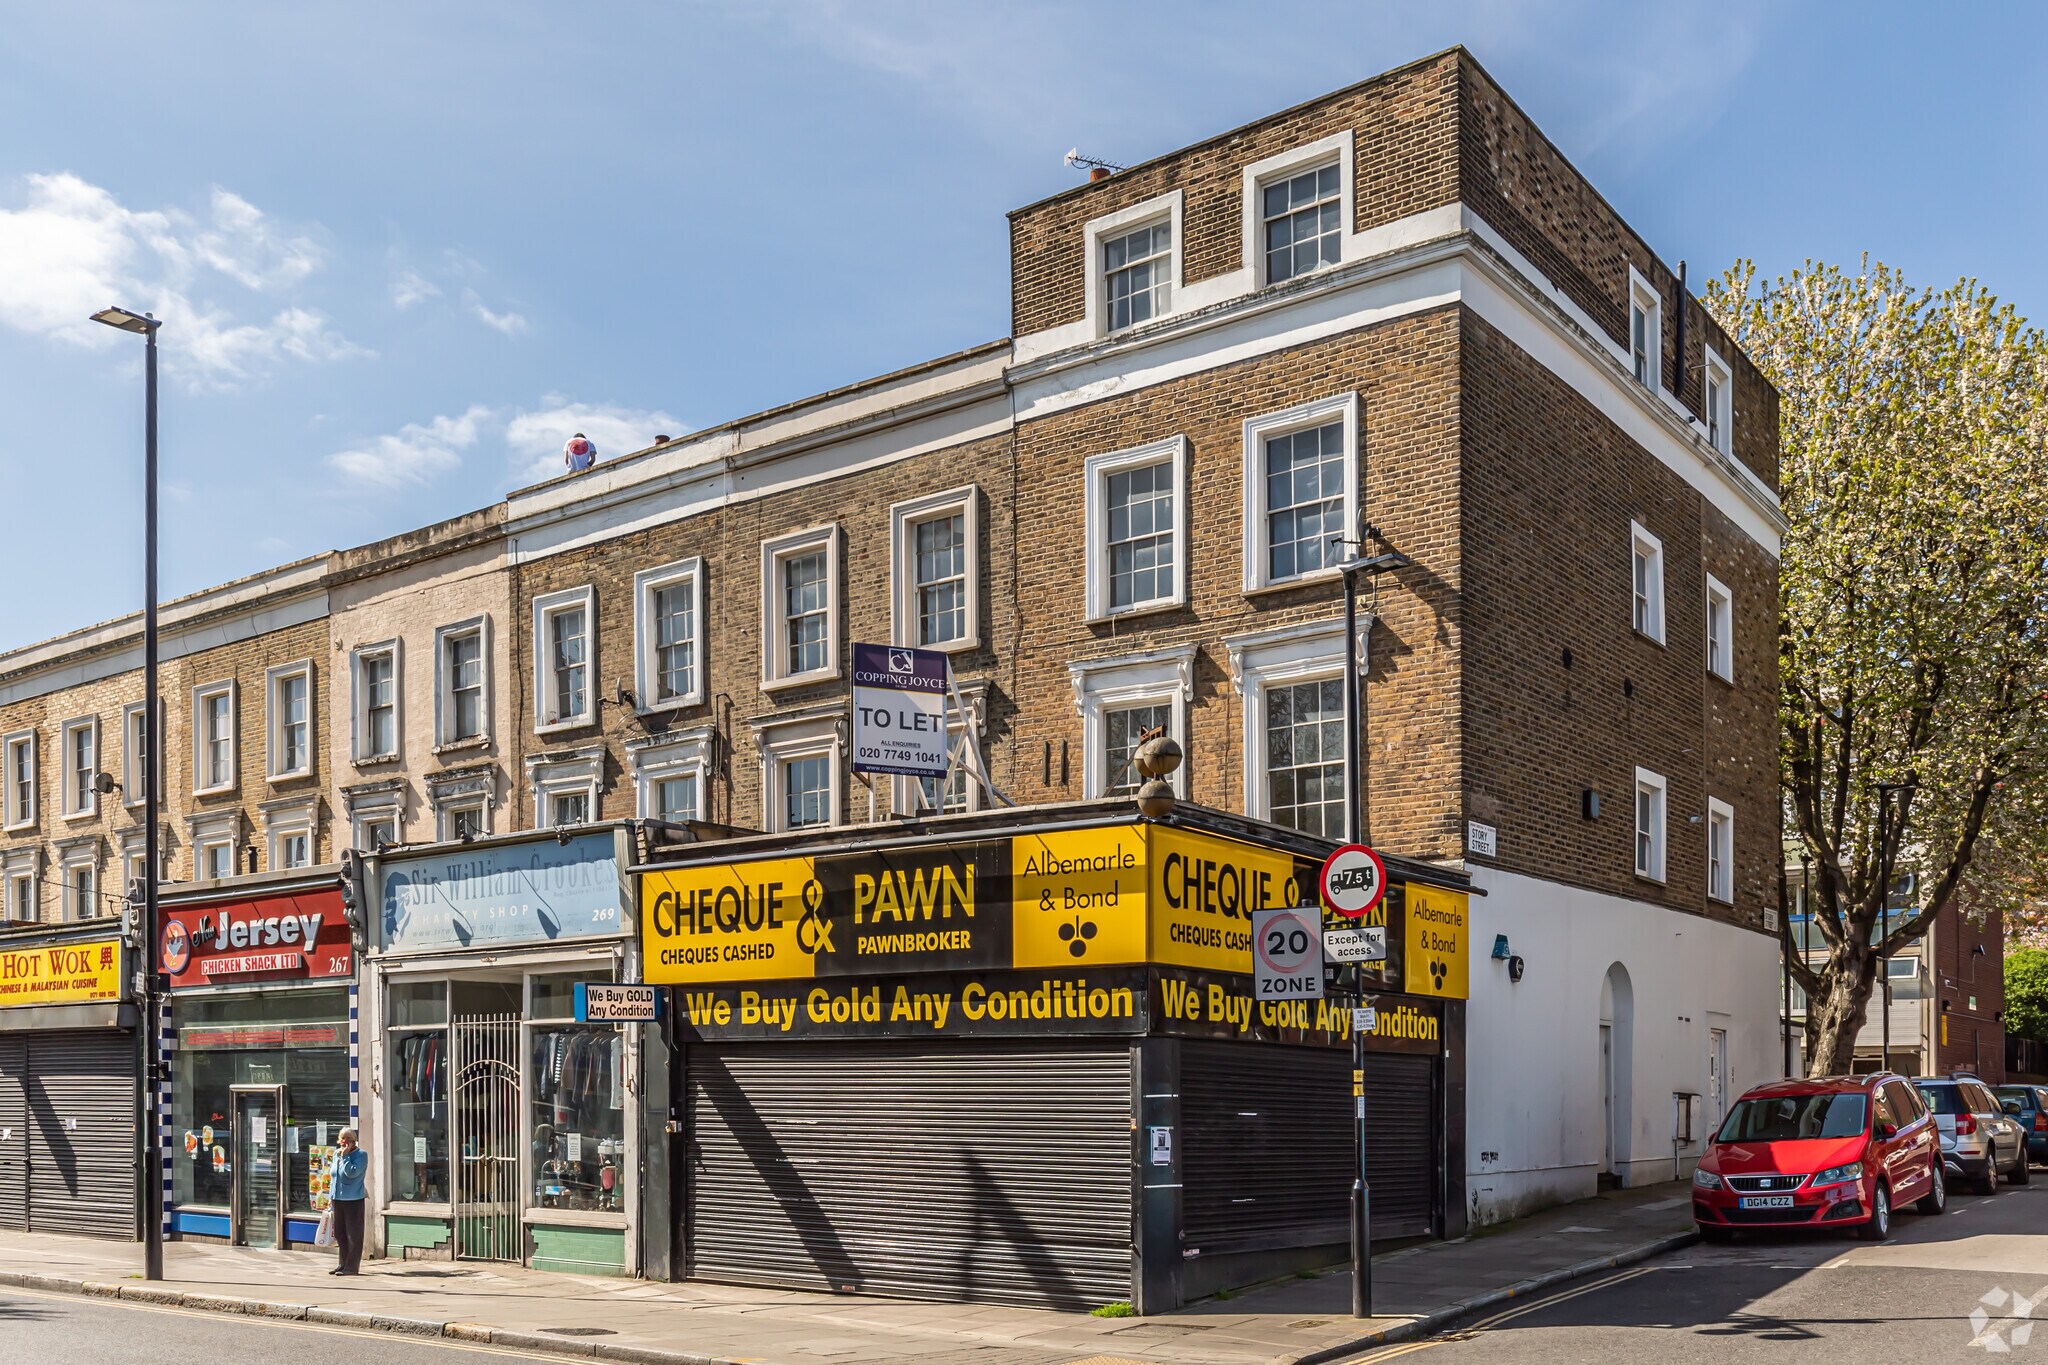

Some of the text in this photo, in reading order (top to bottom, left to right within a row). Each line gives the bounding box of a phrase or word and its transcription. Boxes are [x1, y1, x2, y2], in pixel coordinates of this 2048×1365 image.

[855, 671, 945, 689] COPPING JOYCE
[859, 707, 943, 732] TO LET
[860, 747, 940, 763] 020 7749 1041
[865, 765, 936, 776] www.coppingjoyce.co.uk
[1472, 828, 1488, 841] STORY
[1472, 840, 1490, 853] STREET
[1023, 843, 1136, 878] Albemarle
[411, 847, 615, 905] Sir William Crookes
[1163, 852, 1271, 921] CHEQUE
[1039, 880, 1118, 911] & Bond
[411, 904, 529, 927] CHARITY SHOP
[592, 908, 615, 922] 269
[653, 863, 975, 955] CHEQUE & PAWN
[1413, 898, 1462, 927] Albemarle
[192, 914, 216, 947] New
[214, 911, 323, 952] Jersey
[1170, 923, 1252, 952] CHEQUES CASH
[1328, 932, 1381, 945] Except for
[1421, 930, 1455, 953] & Bond
[660, 942, 775, 966] CHEQUES CASHED
[857, 930, 971, 955] PAWNBROKER
[1267, 930, 1309, 955] 20
[1337, 946, 1372, 957] access
[2, 949, 92, 979] HOT WOK
[202, 953, 297, 975] CHICKEN SHACK LTD
[329, 957, 349, 973] 267
[23, 982, 28, 992] &
[30, 980, 69, 992] MALAYSIAN
[72, 978, 98, 989] CUISINE
[588, 989, 653, 1004] We Buy GOLD
[1262, 977, 1316, 993] ZONE
[589, 1004, 654, 1018] Any Condition
[686, 979, 1133, 1032] We Buy Gold Any Condition
[1161, 978, 1200, 1021] We
[1208, 984, 1253, 1032] Buy
[1260, 1000, 1310, 1029] Gold
[1315, 998, 1351, 1040] Any
[1747, 1197, 1790, 1207] DG14 CZZ
